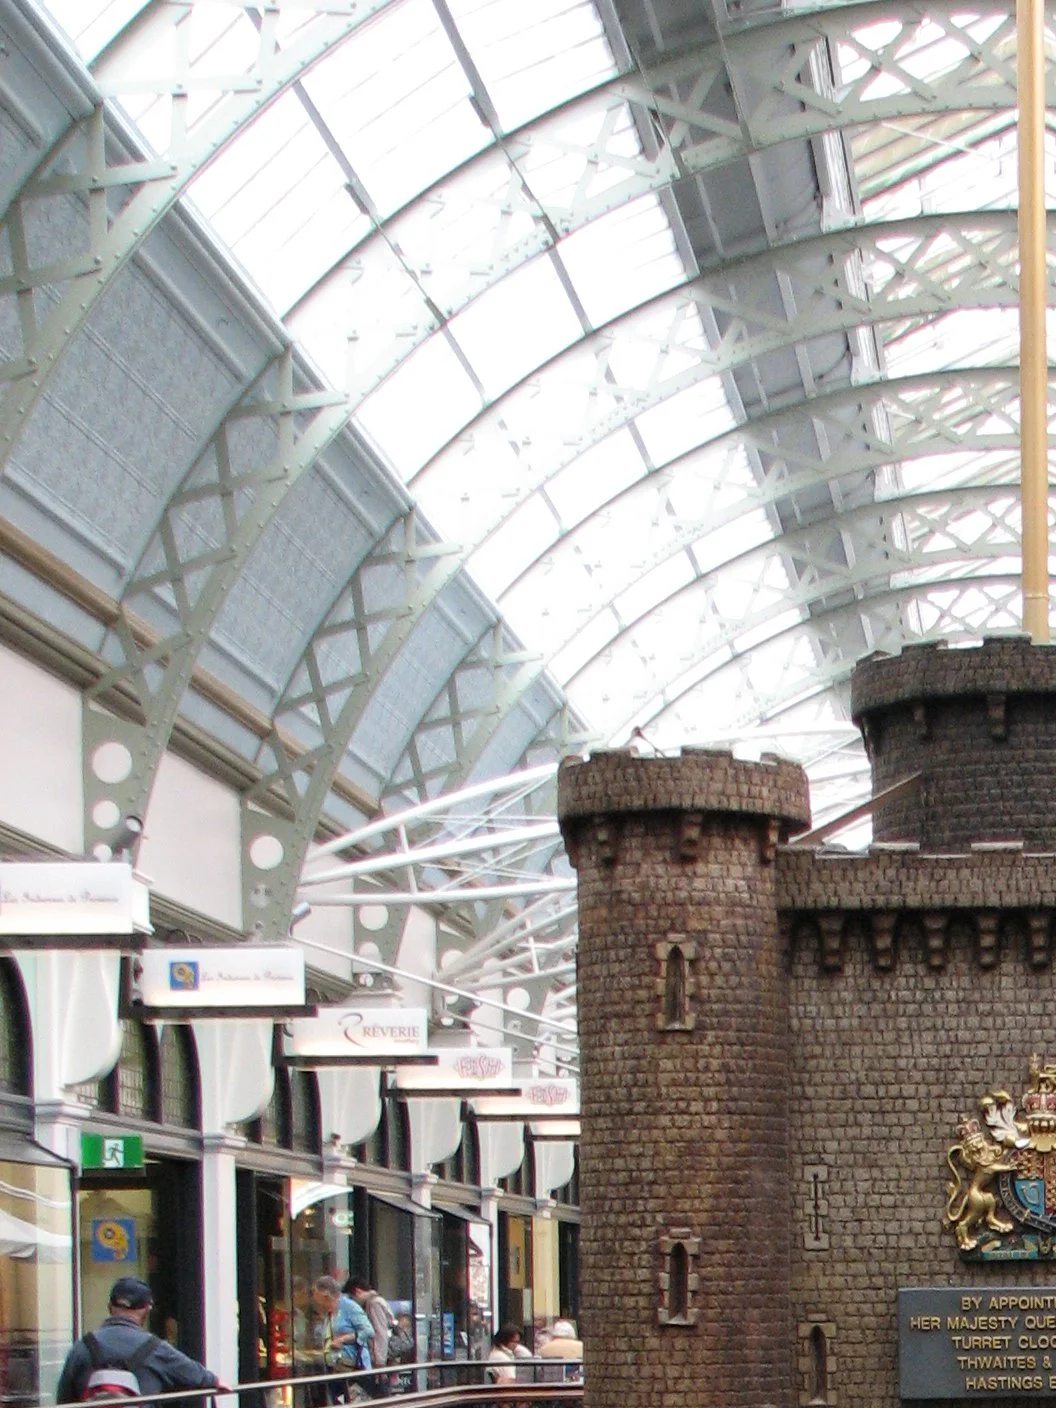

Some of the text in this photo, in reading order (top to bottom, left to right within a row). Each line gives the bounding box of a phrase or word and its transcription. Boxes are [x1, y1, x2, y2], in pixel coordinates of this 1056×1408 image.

[961, 1296, 982, 1310] BY
[910, 1316, 941, 1330] HER
[947, 1316, 1018, 1330] MAJESTY
[952, 1336, 1011, 1350] TURRET
[957, 1355, 1037, 1370] THWAITES
[1042, 1355, 1052, 1369] &
[966, 1376, 1043, 1390] HASTINGS
